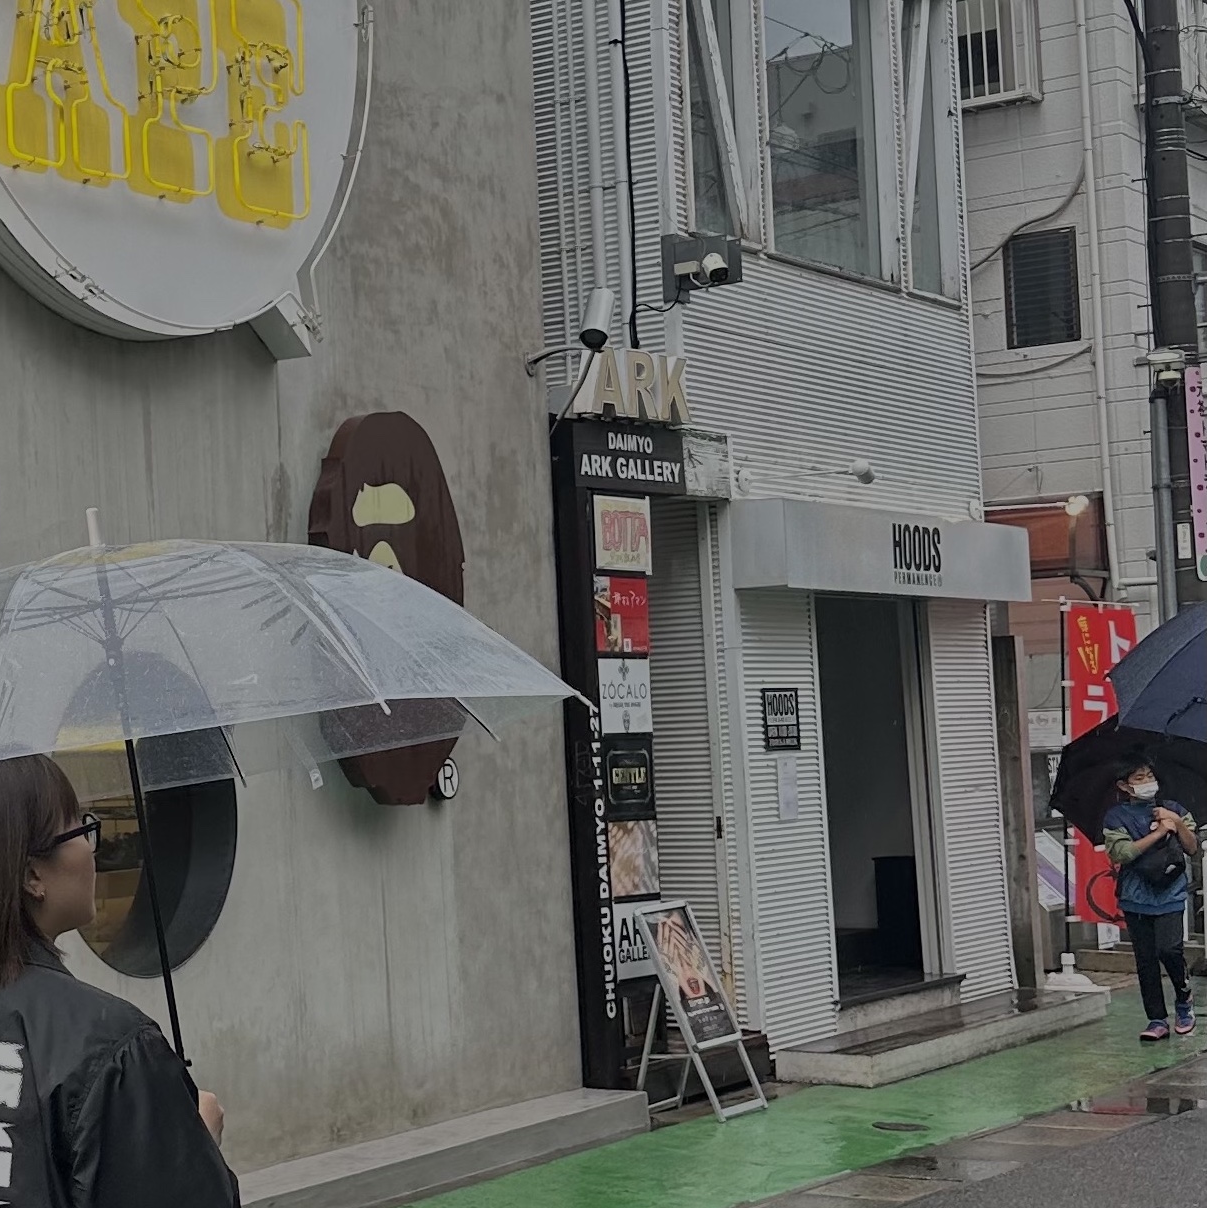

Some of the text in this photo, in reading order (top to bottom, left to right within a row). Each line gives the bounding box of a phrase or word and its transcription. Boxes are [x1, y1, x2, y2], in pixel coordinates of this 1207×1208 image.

[592, 346, 692, 423] ARK
[608, 432, 653, 454] DAIMYO
[580, 454, 681, 483] ARK GALLERY
[892, 523, 942, 573] HOODS
[601, 680, 648, 700] ZÓCALO
[767, 693, 795, 717] HOODS
[594, 798, 612, 899] DAIMYO
[600, 906, 618, 1019] CHUOKU
